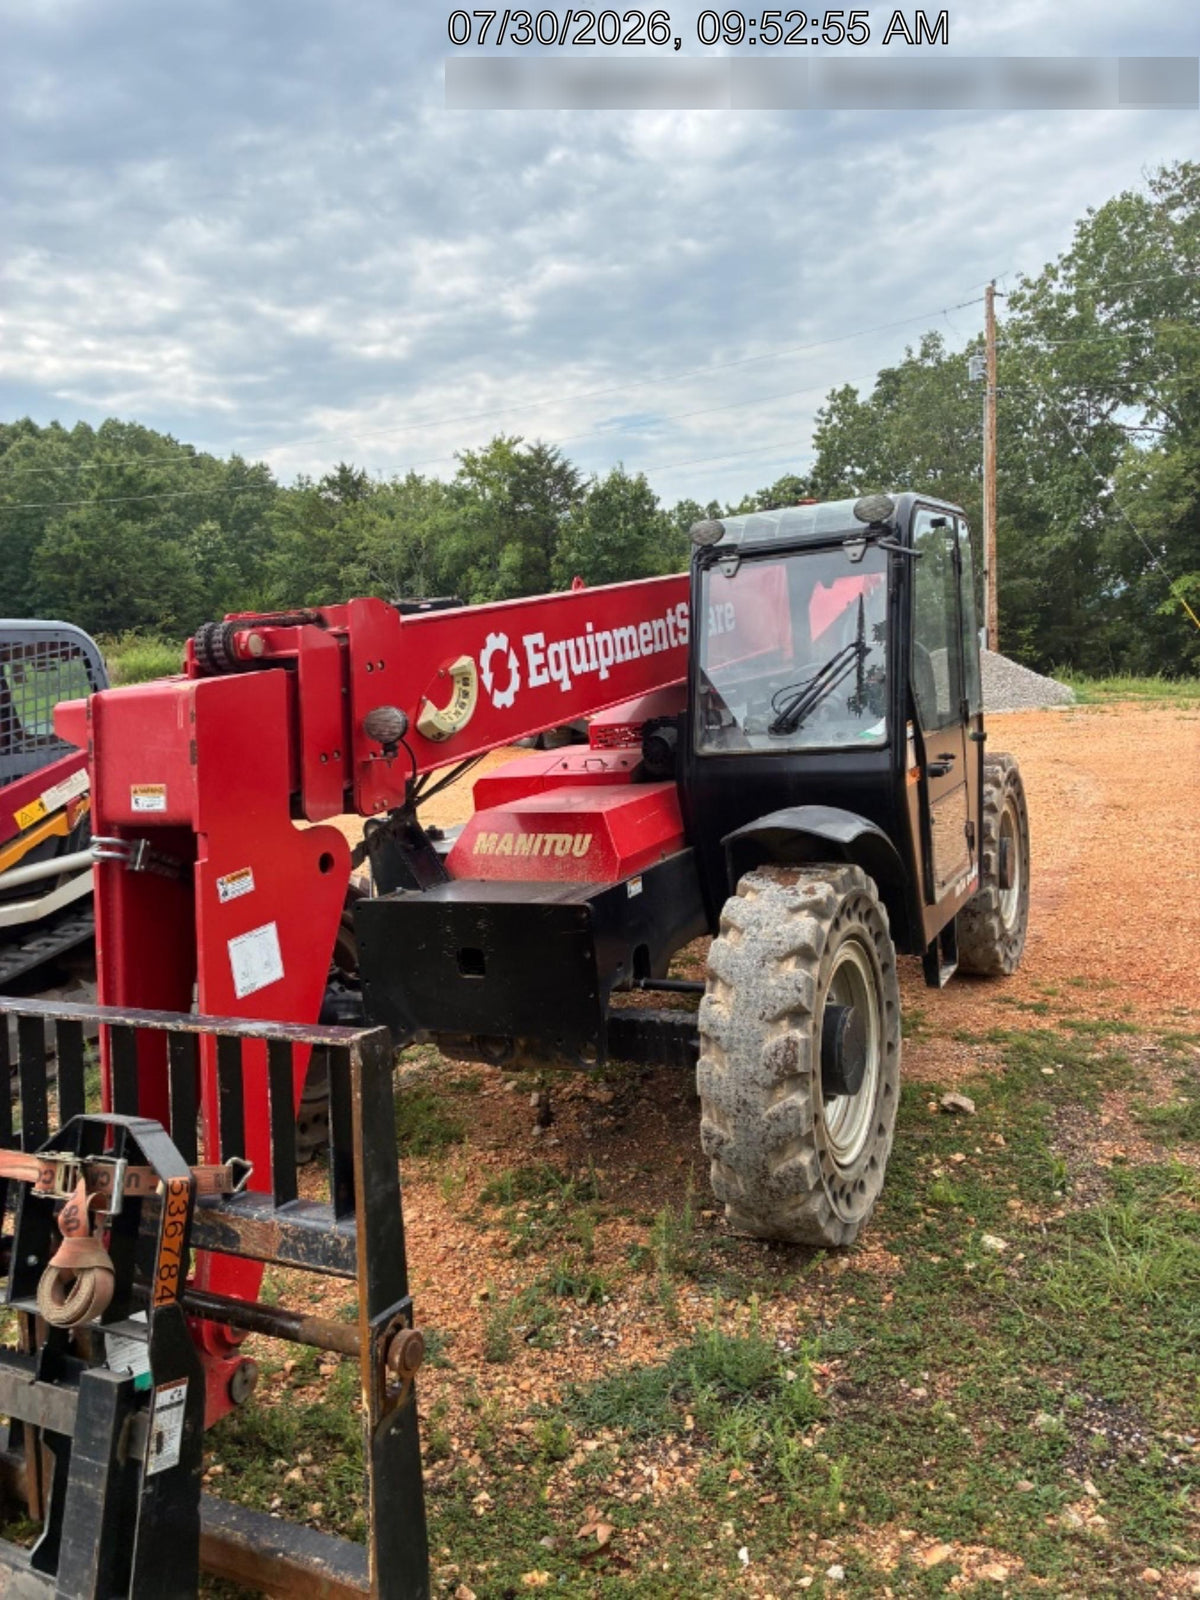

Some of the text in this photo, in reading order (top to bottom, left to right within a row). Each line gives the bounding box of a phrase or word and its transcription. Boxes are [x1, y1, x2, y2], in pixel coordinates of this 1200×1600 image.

[522, 601, 736, 692] EquipmentSare
[472, 832, 593, 858] MANITOU
[155, 1180, 189, 1303] 536784
